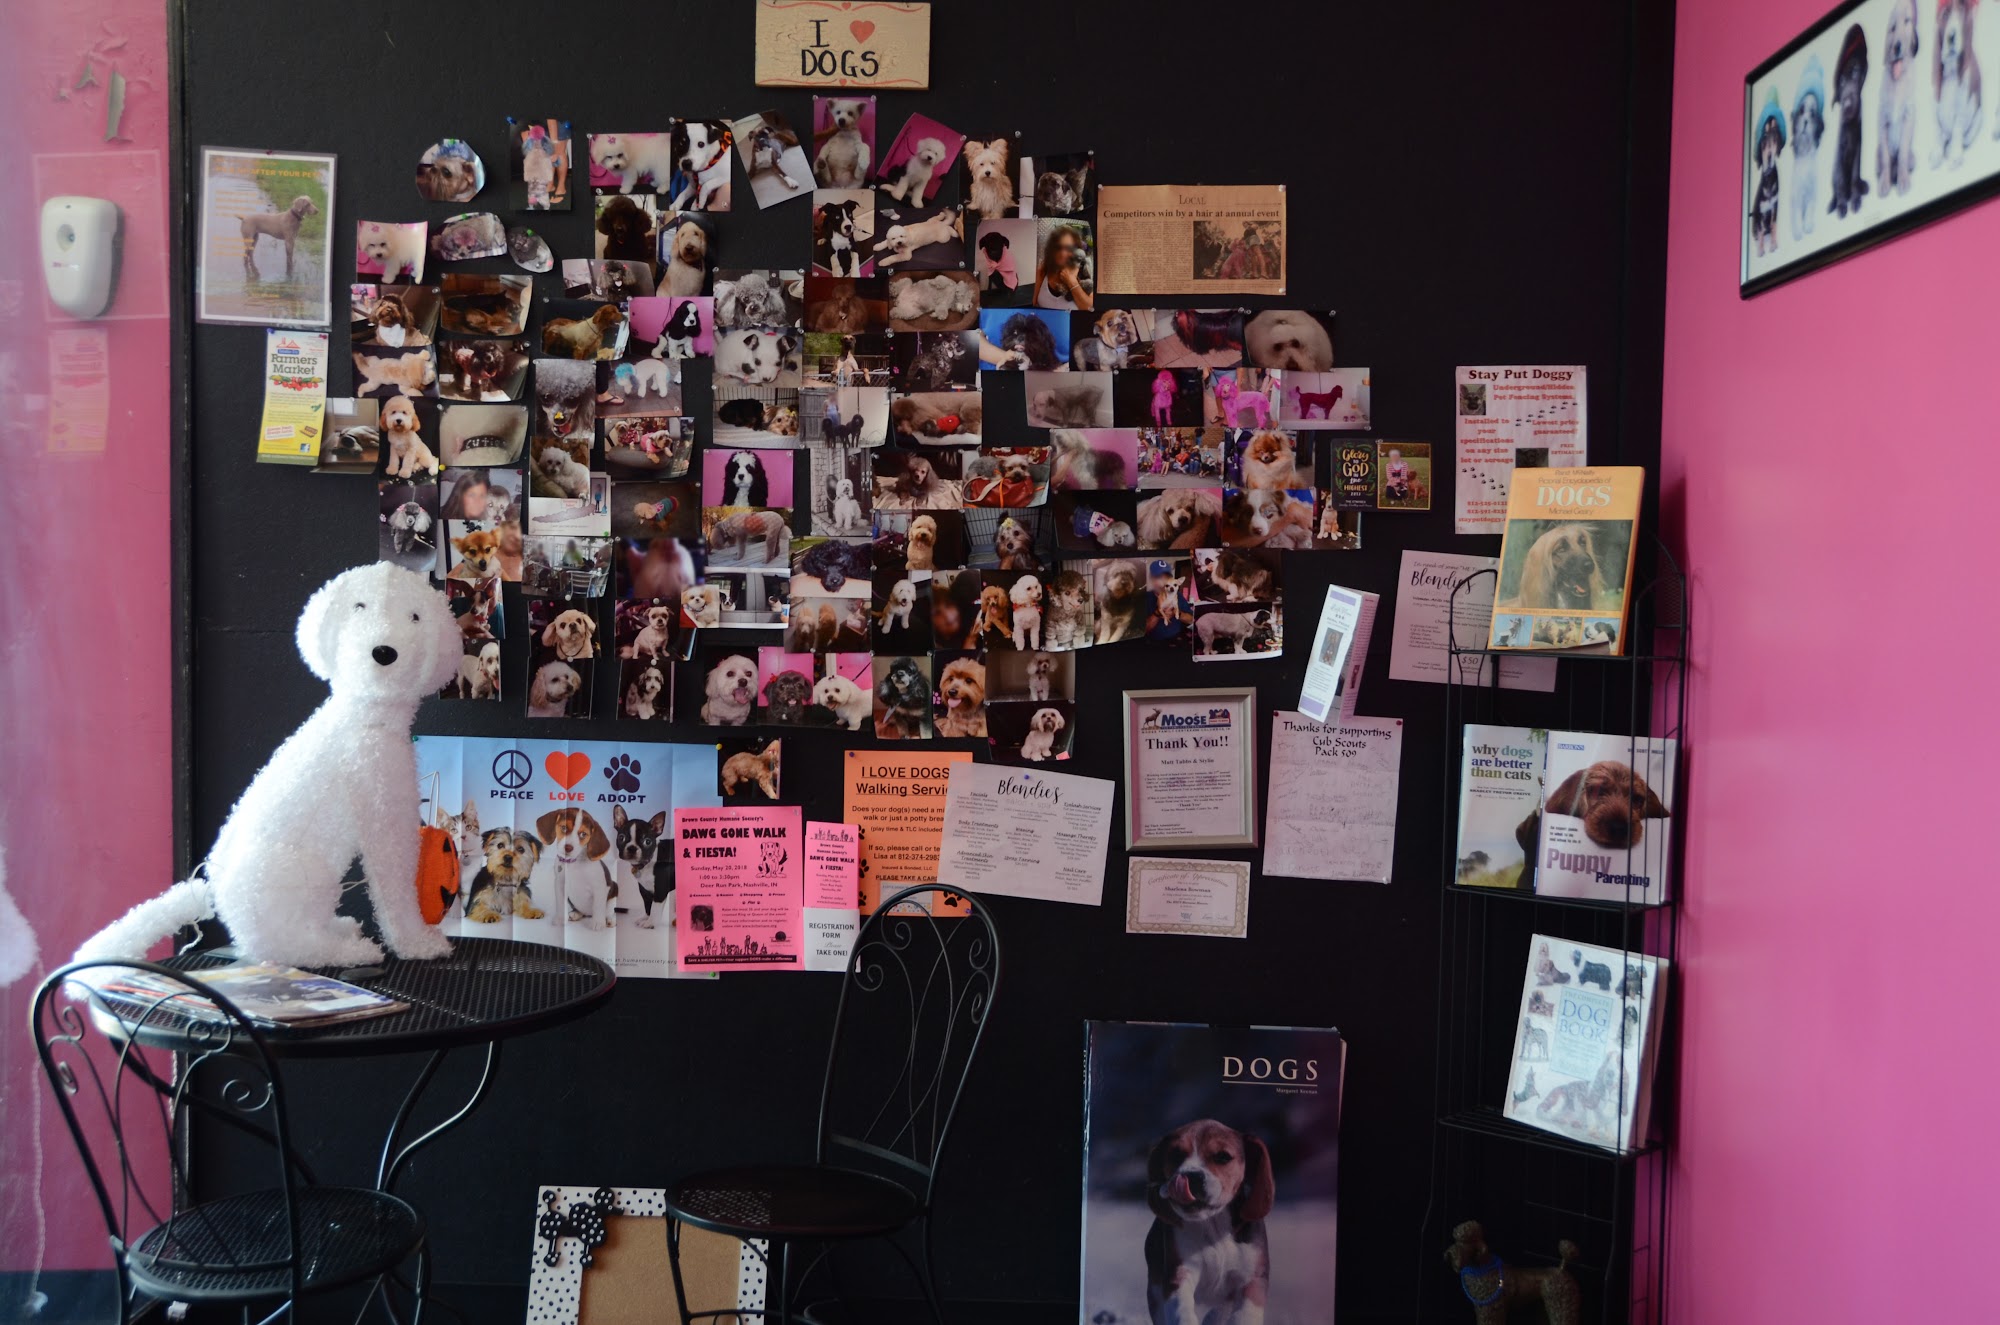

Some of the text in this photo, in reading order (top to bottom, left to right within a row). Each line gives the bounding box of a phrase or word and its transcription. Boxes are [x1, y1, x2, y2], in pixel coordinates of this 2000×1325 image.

[809, 20, 830, 47] I
[801, 49, 879, 77] DOGS
[1179, 194, 1206, 205] LOCAL
[1103, 210, 1156, 219] Competitors
[1176, 210, 1186, 219] by
[271, 354, 317, 365] Farmers
[273, 364, 315, 375] Market
[1469, 369, 1574, 381] Stay Put Doggy
[1343, 449, 1369, 461] Glory
[1343, 462, 1369, 476] GOD
[1536, 486, 1613, 506] DOGS
[1462, 656, 1478, 665] $50
[1161, 714, 1206, 726] MOOSE
[1283, 721, 1392, 740] Thanks for supporting
[1145, 736, 1228, 750] Thank You!!
[1313, 736, 1366, 749] Cub Scouts
[1315, 747, 1357, 758] Pack 509
[1472, 744, 1533, 759] why dogs
[1495, 758, 1532, 769] better
[862, 766, 949, 778] I LOVE DOGS
[1471, 767, 1531, 780] than cats
[490, 789, 534, 800] PEACE
[549, 791, 585, 801] LOVE
[856, 783, 907, 797] Walking
[997, 776, 1063, 804] Blondie's
[597, 793, 646, 804] ADOPT
[682, 827, 786, 839] DAWG GONE WALK
[683, 847, 737, 858] & FIESTA!
[1547, 848, 1611, 875] Puppy
[1595, 872, 1650, 887] Parenting
[1562, 999, 1608, 1027] DOG
[1559, 1020, 1605, 1043] BOOK
[1223, 1056, 1318, 1080] DOGS
